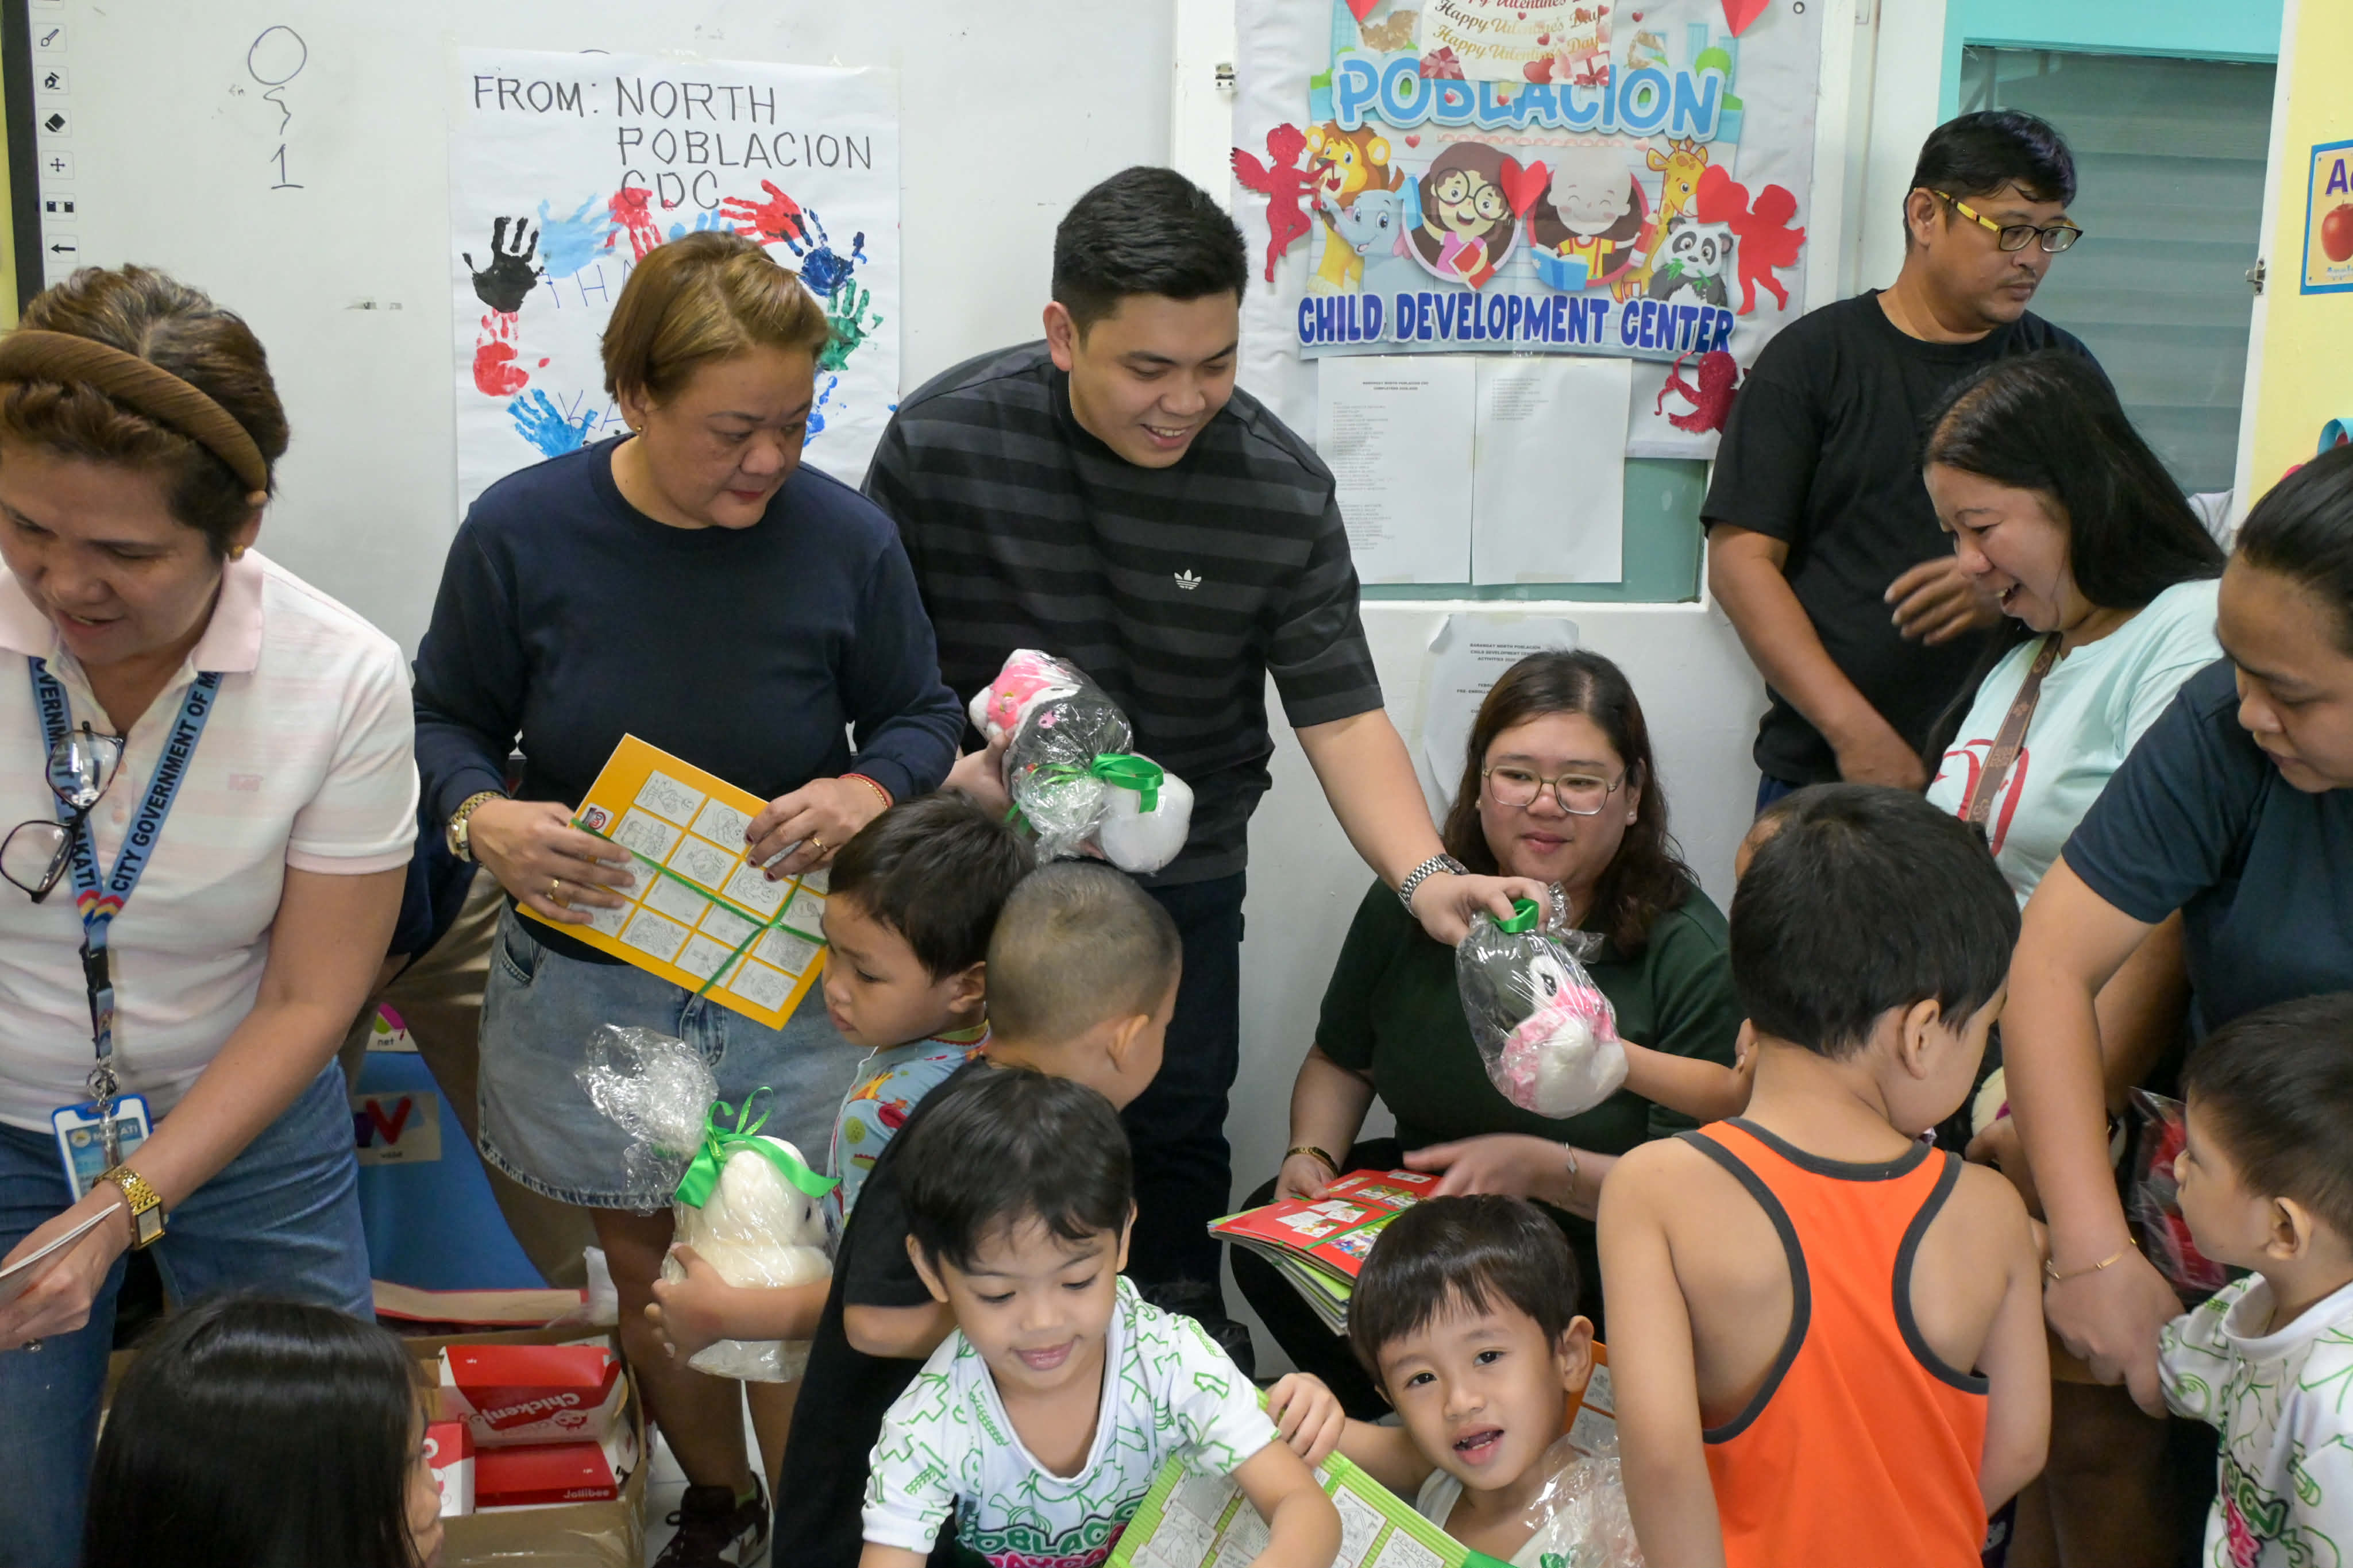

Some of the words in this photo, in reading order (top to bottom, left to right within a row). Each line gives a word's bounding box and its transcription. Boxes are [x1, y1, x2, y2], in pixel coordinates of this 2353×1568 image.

[1435, 0, 1488, 33] Happy
[1433, 24, 1487, 60] Happy
[473, 75, 599, 117] FROM:
[616, 76, 776, 125] NORTH
[617, 126, 872, 169] POBLACION
[620, 169, 720, 210] CDC
[1298, 293, 1383, 343] CHILD
[1396, 293, 1609, 343] DEVELOPMENT
[1621, 301, 1734, 352] CENTER
[111, 848, 142, 892] CITY
[132, 719, 198, 847] GOVERNMENT
[187, 690, 208, 717] OF
